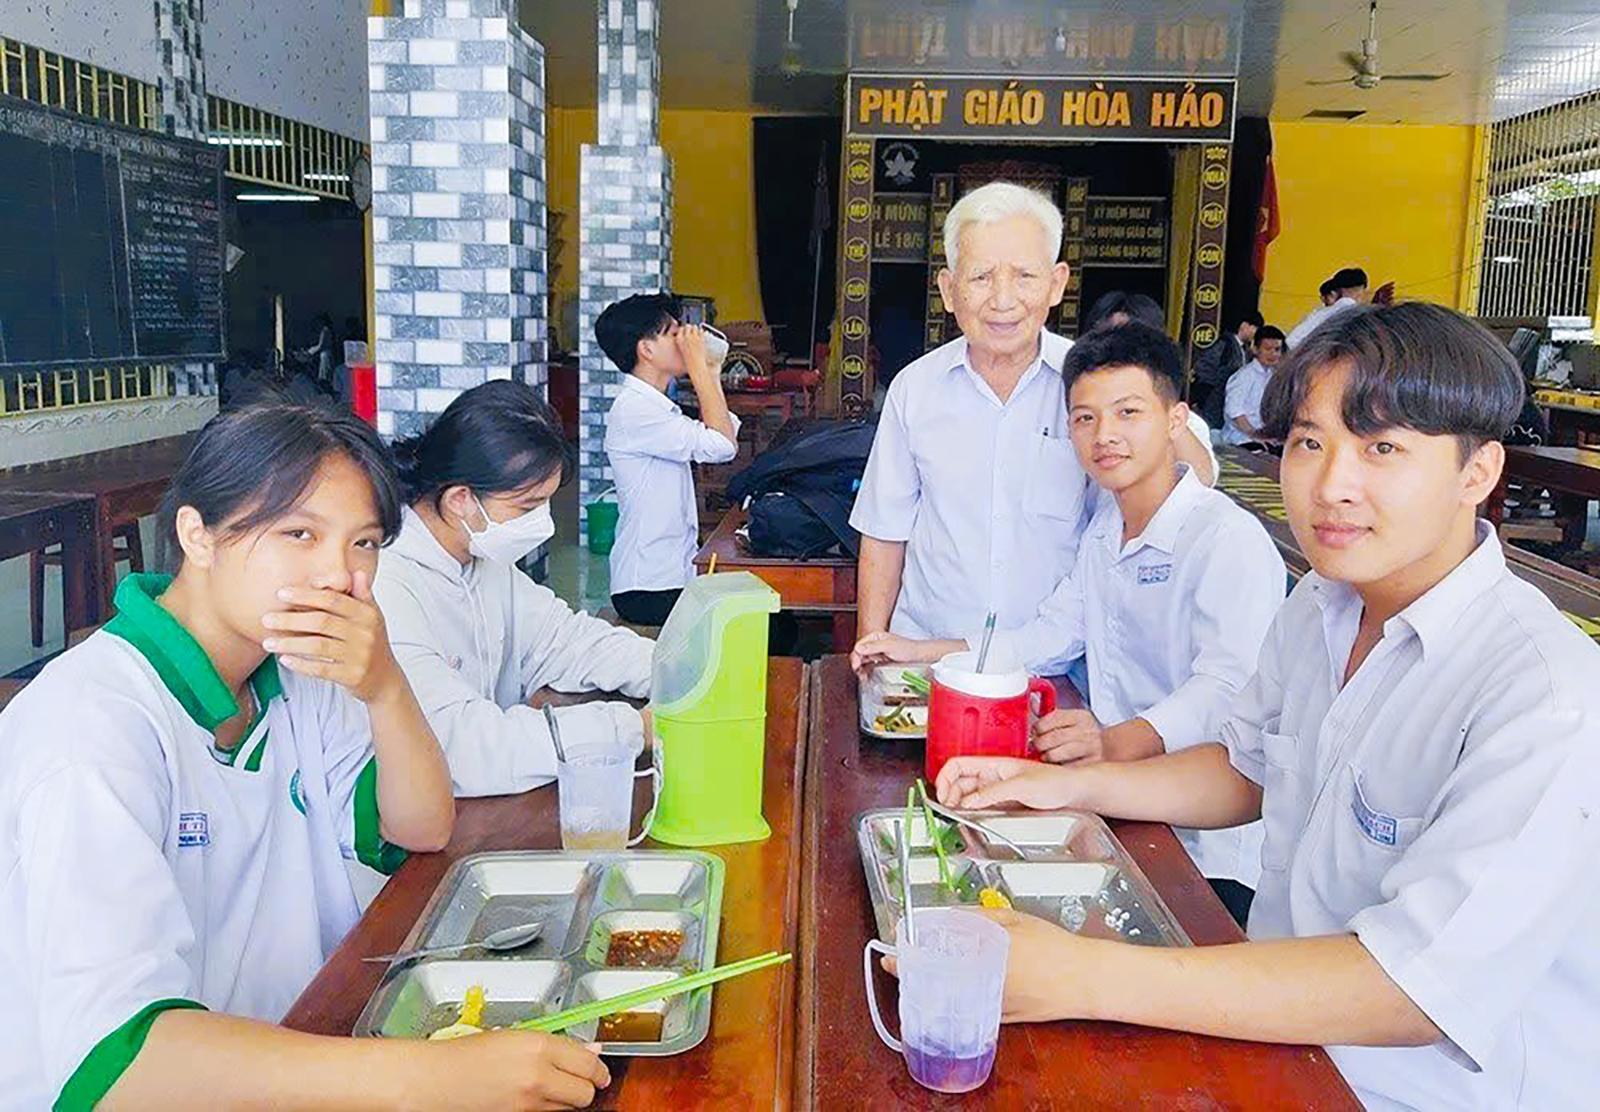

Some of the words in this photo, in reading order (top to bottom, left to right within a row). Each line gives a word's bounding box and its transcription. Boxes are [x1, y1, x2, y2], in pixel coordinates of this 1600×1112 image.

[858, 80, 948, 131] PHẬT
[963, 81, 1045, 127] GIÁO
[1061, 81, 1131, 127] HÒA
[1150, 81, 1224, 128] HẢO
